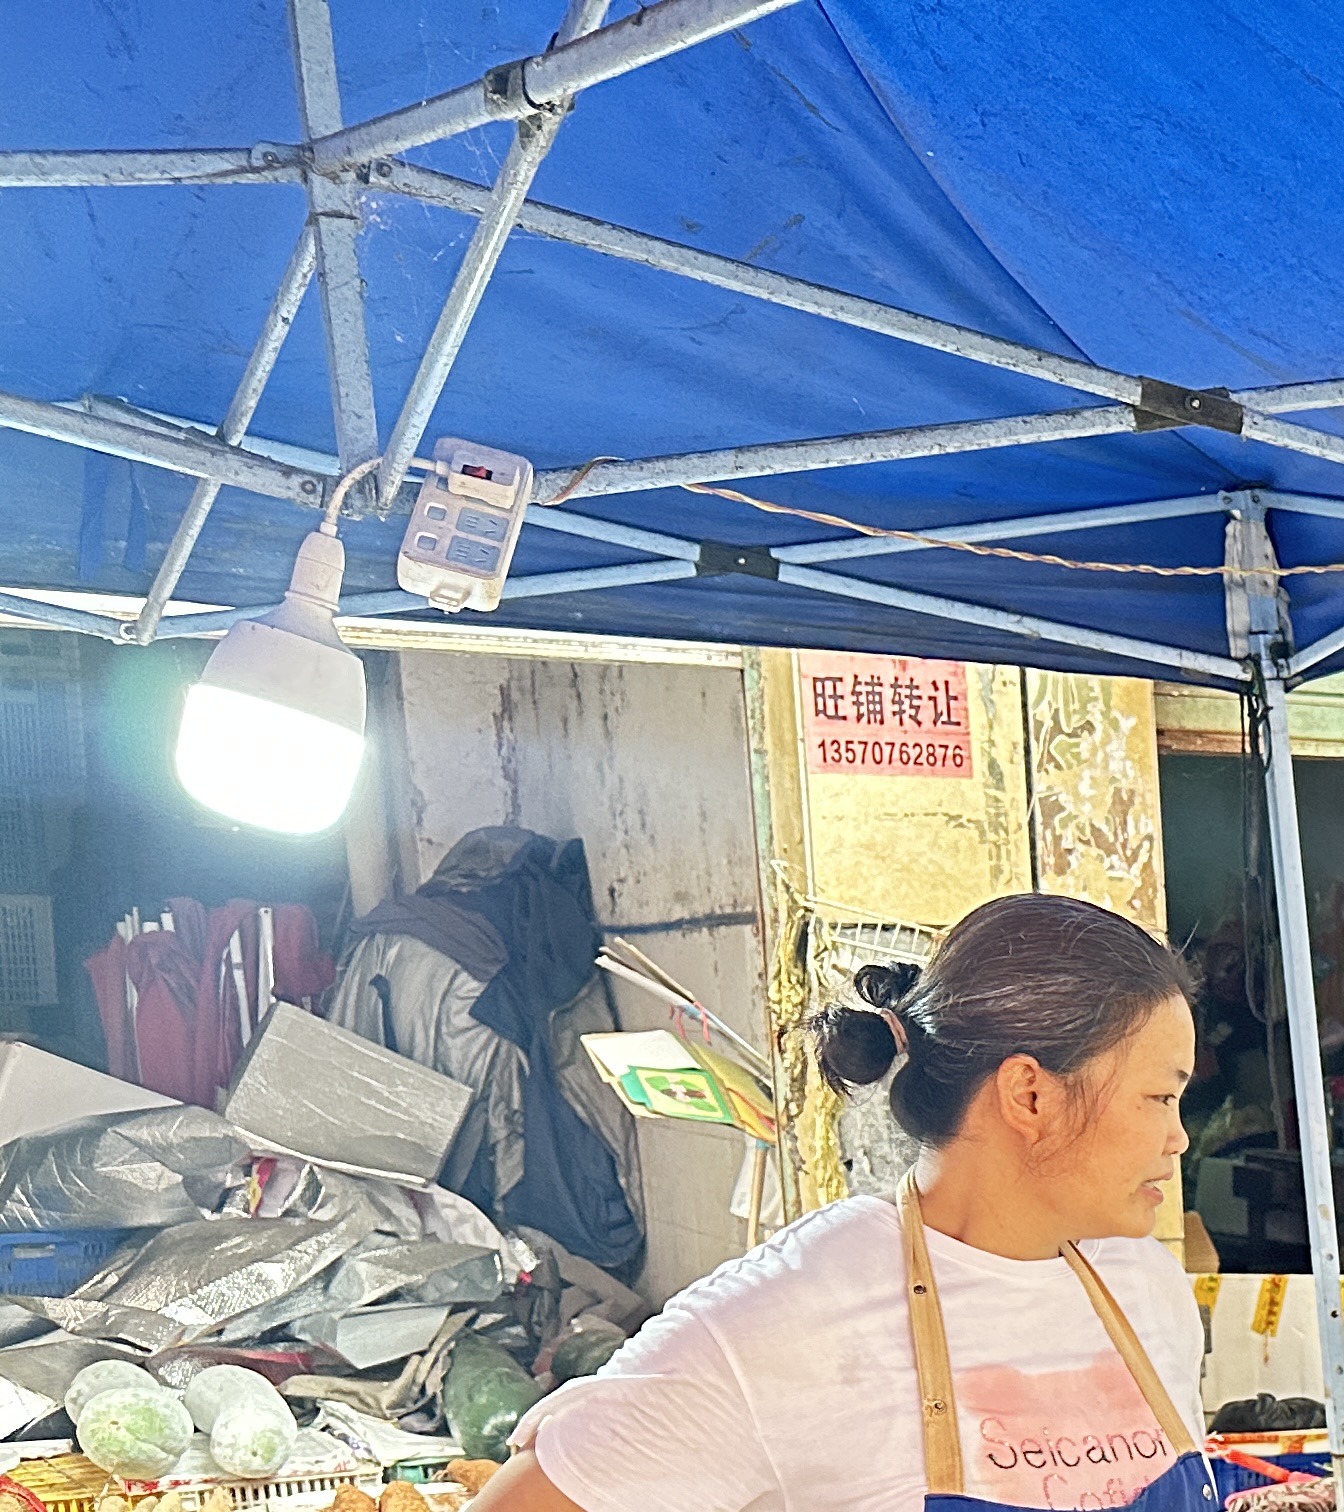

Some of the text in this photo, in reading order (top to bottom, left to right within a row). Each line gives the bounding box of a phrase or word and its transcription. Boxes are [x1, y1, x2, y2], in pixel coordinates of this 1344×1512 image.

[812, 673, 962, 728] 旺铺转让
[816, 738, 964, 769] 13570762876
